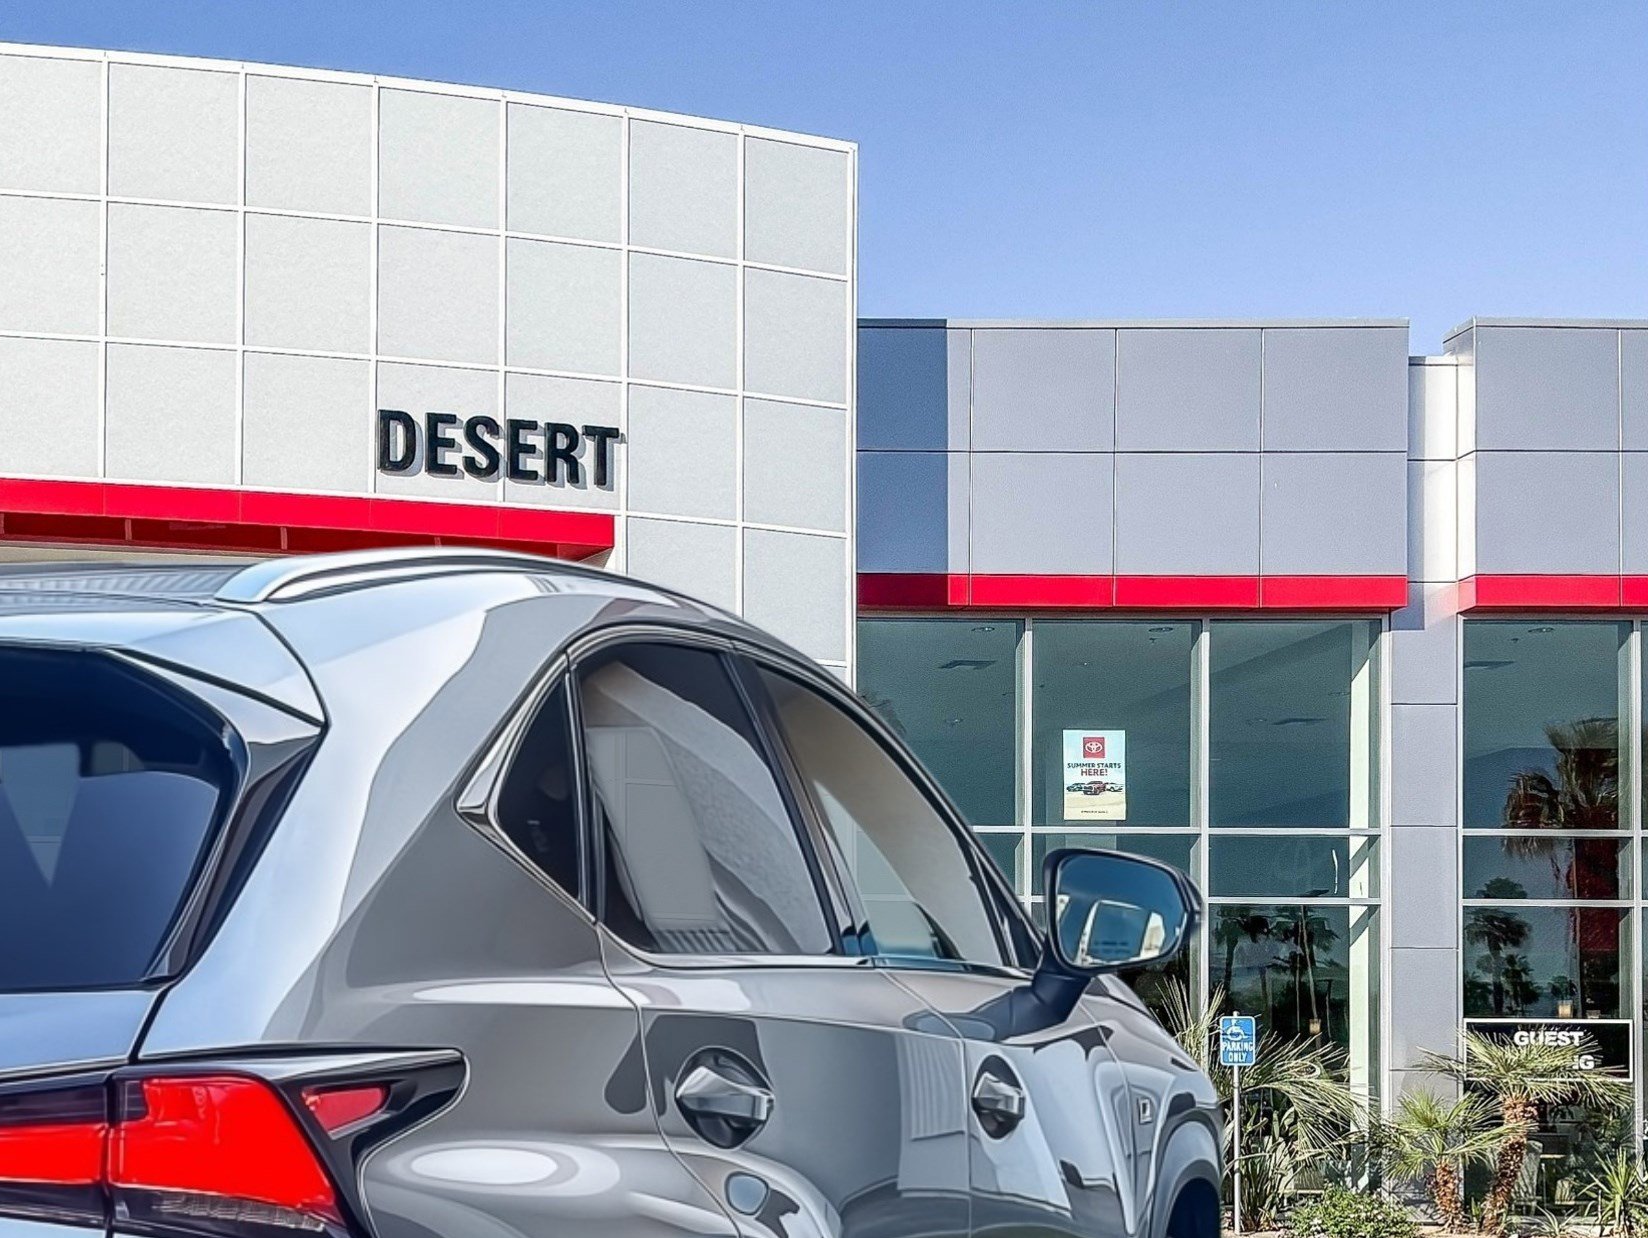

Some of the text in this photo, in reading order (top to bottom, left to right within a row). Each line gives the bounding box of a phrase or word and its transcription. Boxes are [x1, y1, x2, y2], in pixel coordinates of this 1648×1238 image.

[376, 409, 620, 487] DESERT
[1513, 1030, 1584, 1046] GUEST
[1222, 1041, 1254, 1051] PARKING
[1228, 1051, 1248, 1062] ONLY
